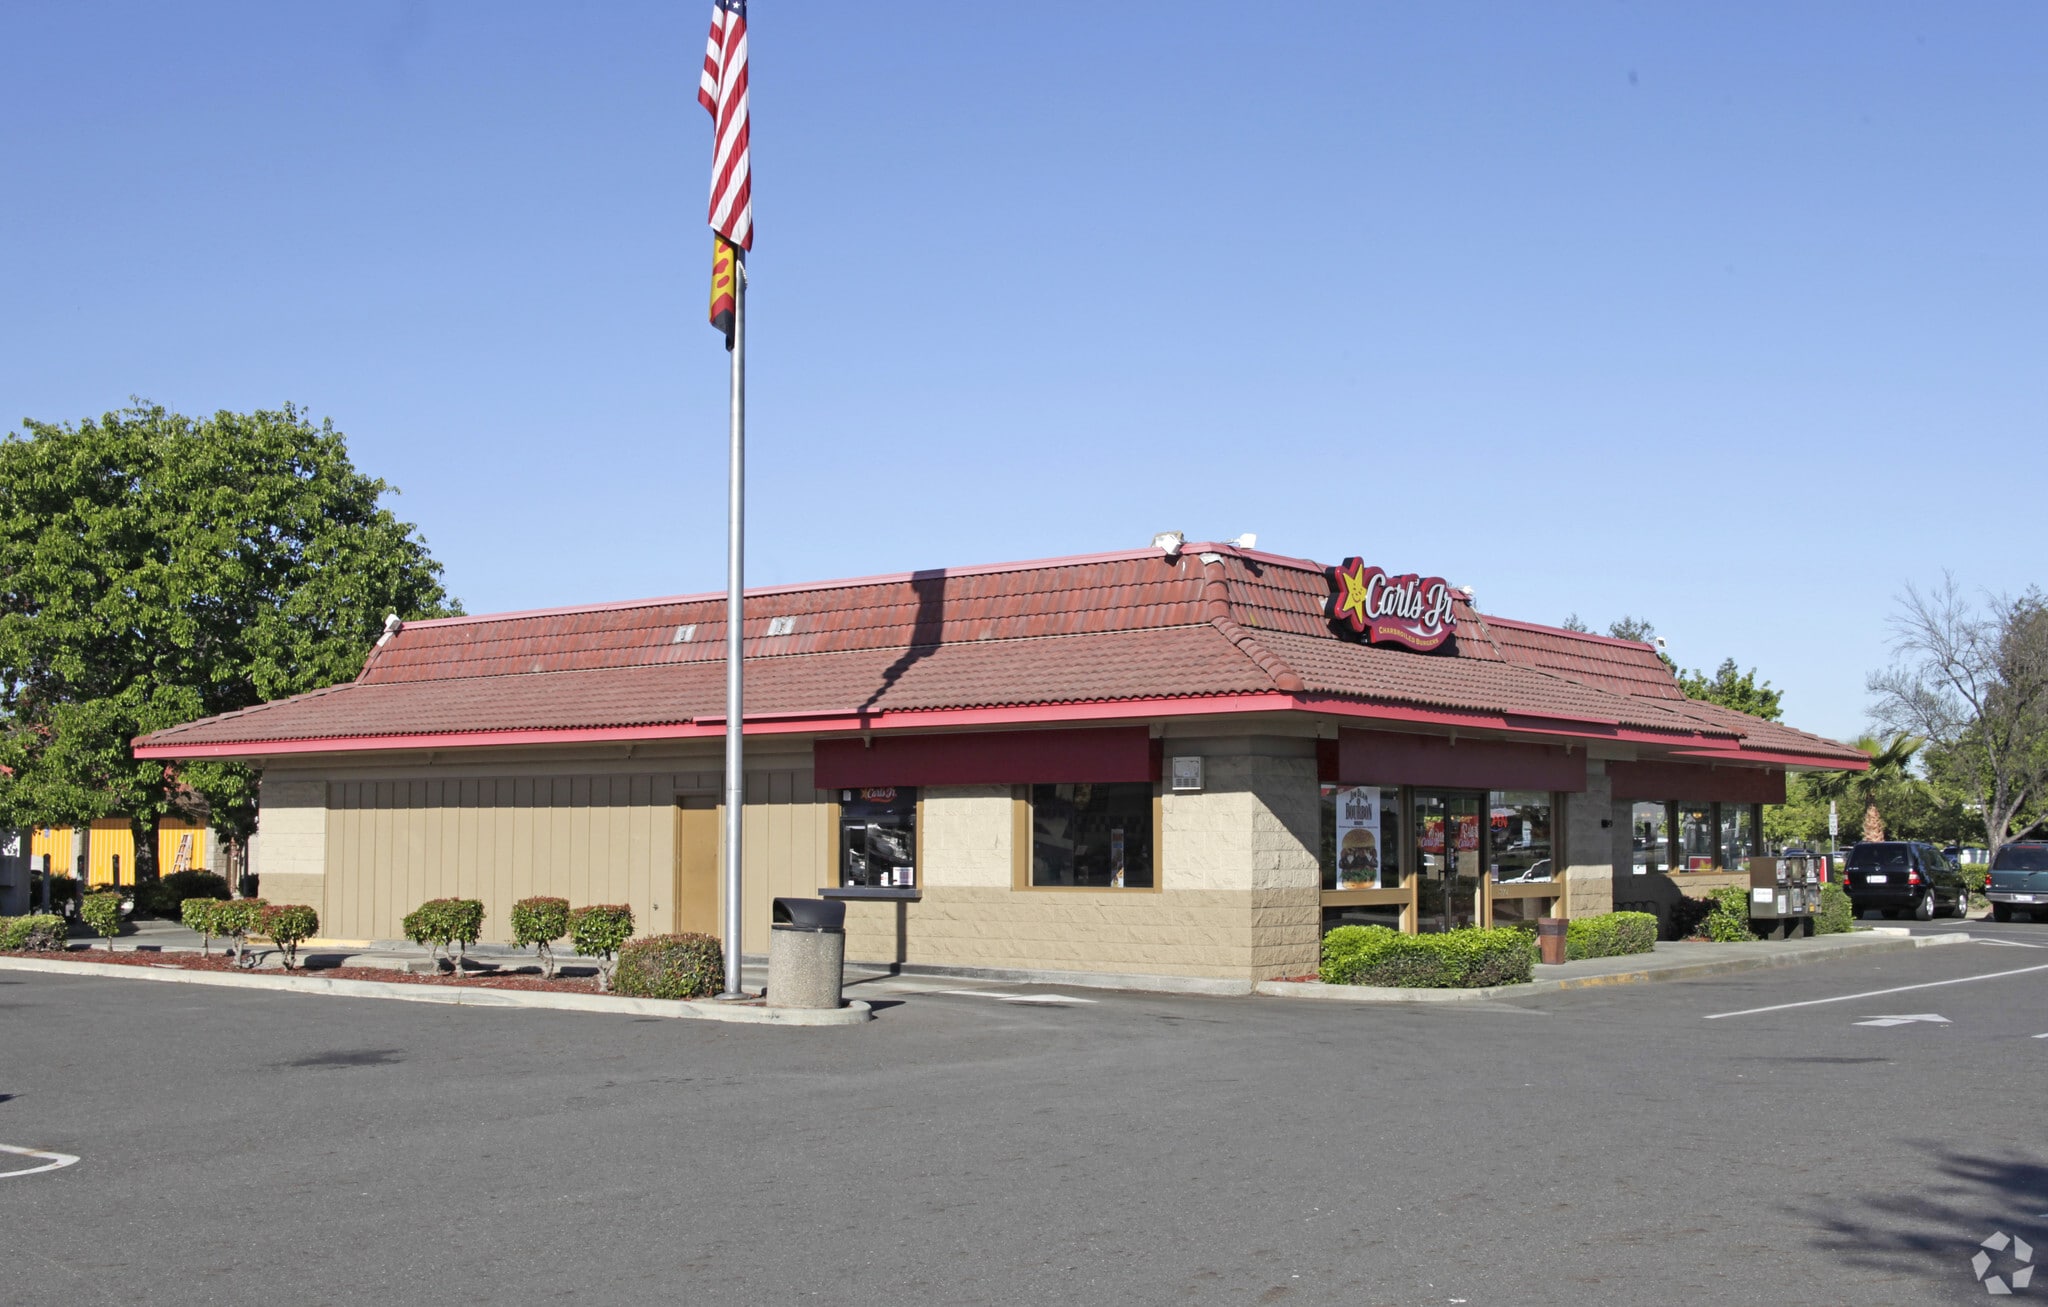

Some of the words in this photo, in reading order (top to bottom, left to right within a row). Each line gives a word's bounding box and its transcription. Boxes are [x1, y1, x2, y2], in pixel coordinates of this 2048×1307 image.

[1366, 573, 1425, 619] Carl's
[1424, 583, 1457, 627] Jr.
[1345, 802, 1372, 820] BOURBON
